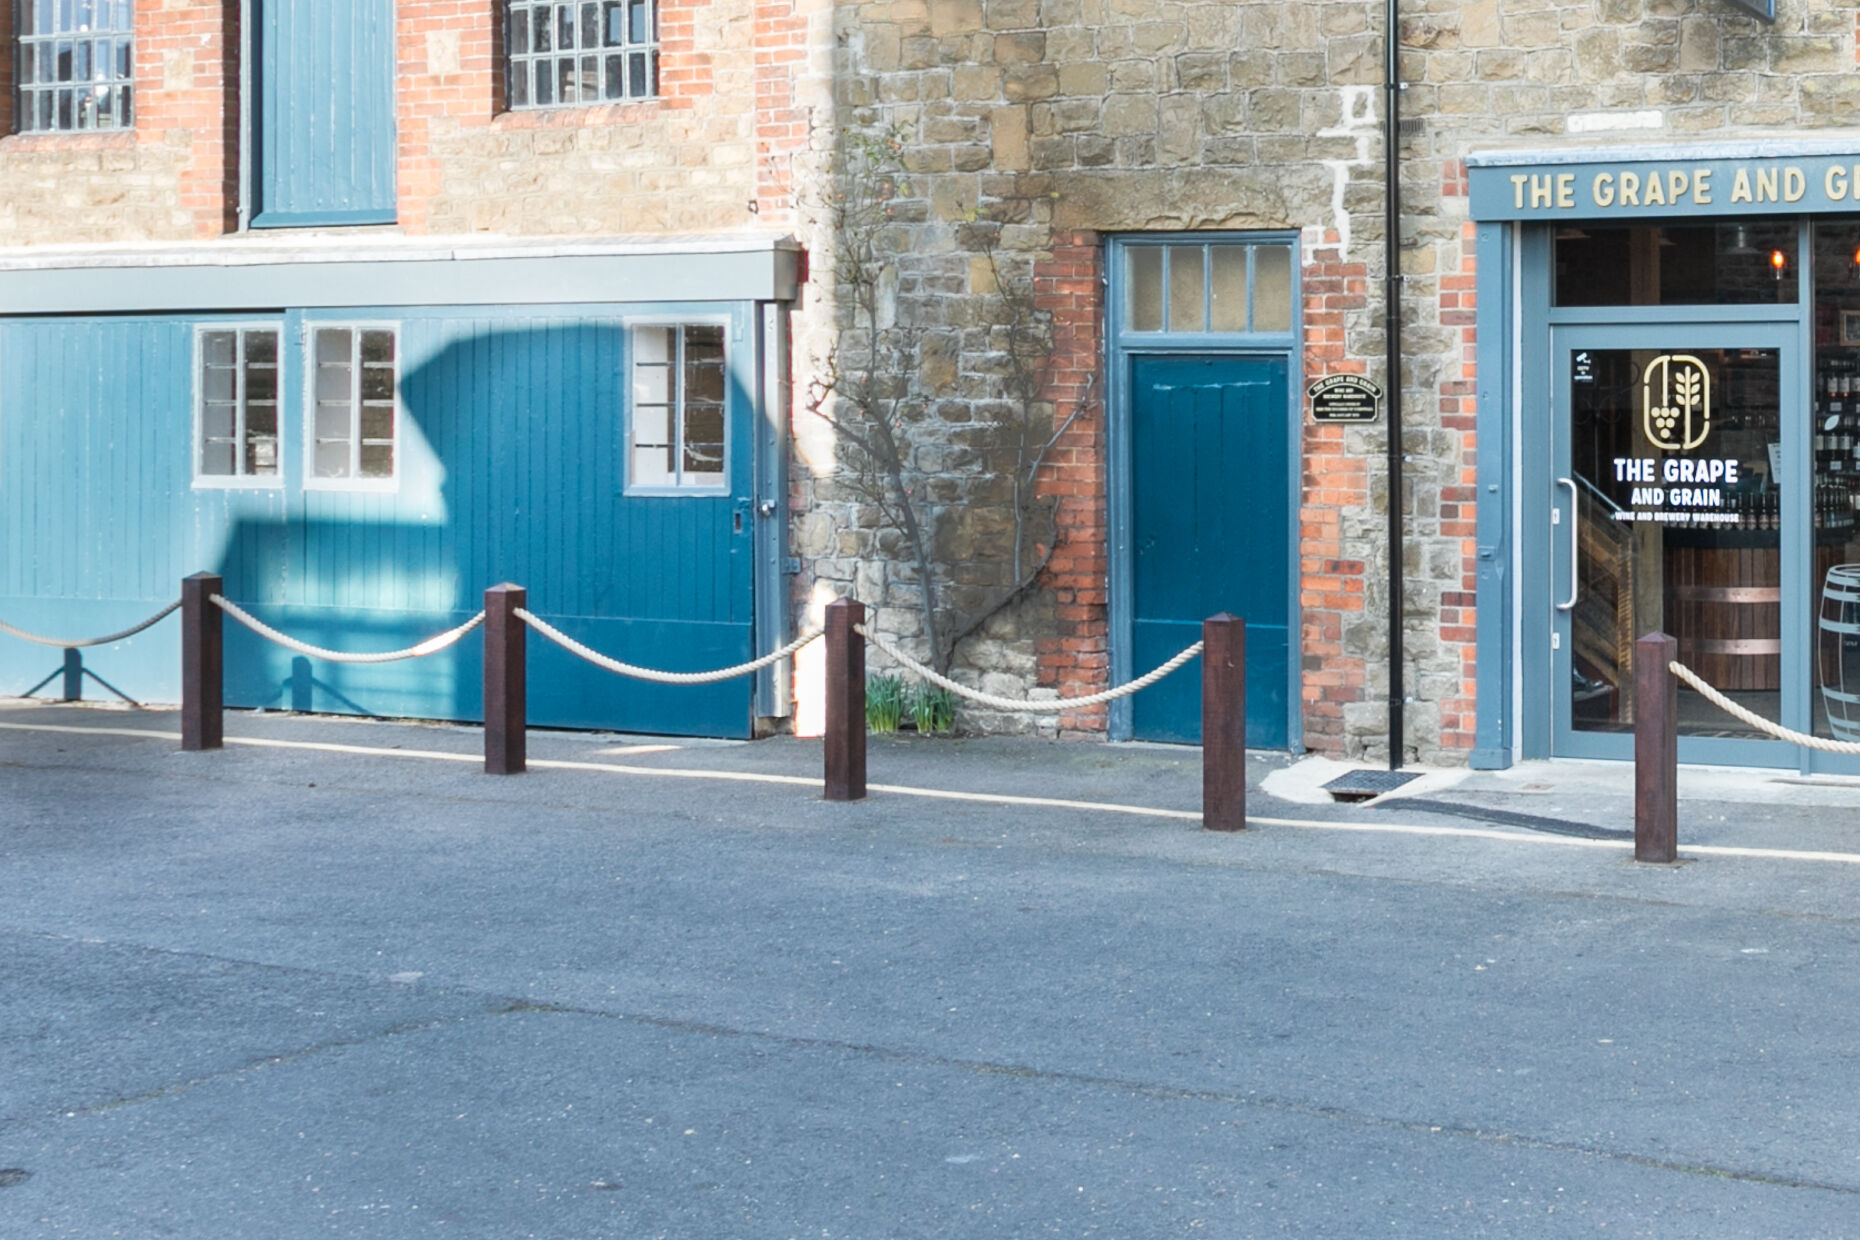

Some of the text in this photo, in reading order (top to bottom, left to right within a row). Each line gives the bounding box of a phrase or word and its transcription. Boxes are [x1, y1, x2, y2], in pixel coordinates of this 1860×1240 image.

[1510, 173, 1575, 209] THE
[1592, 170, 1712, 208] GRAPE
[1732, 167, 1806, 203] AND
[1613, 458, 1738, 483] THE GRAPE
[1631, 488, 1720, 506] AND GRAIN
[1615, 512, 1739, 523] WINE AND BREWERY WAREHOUSE
